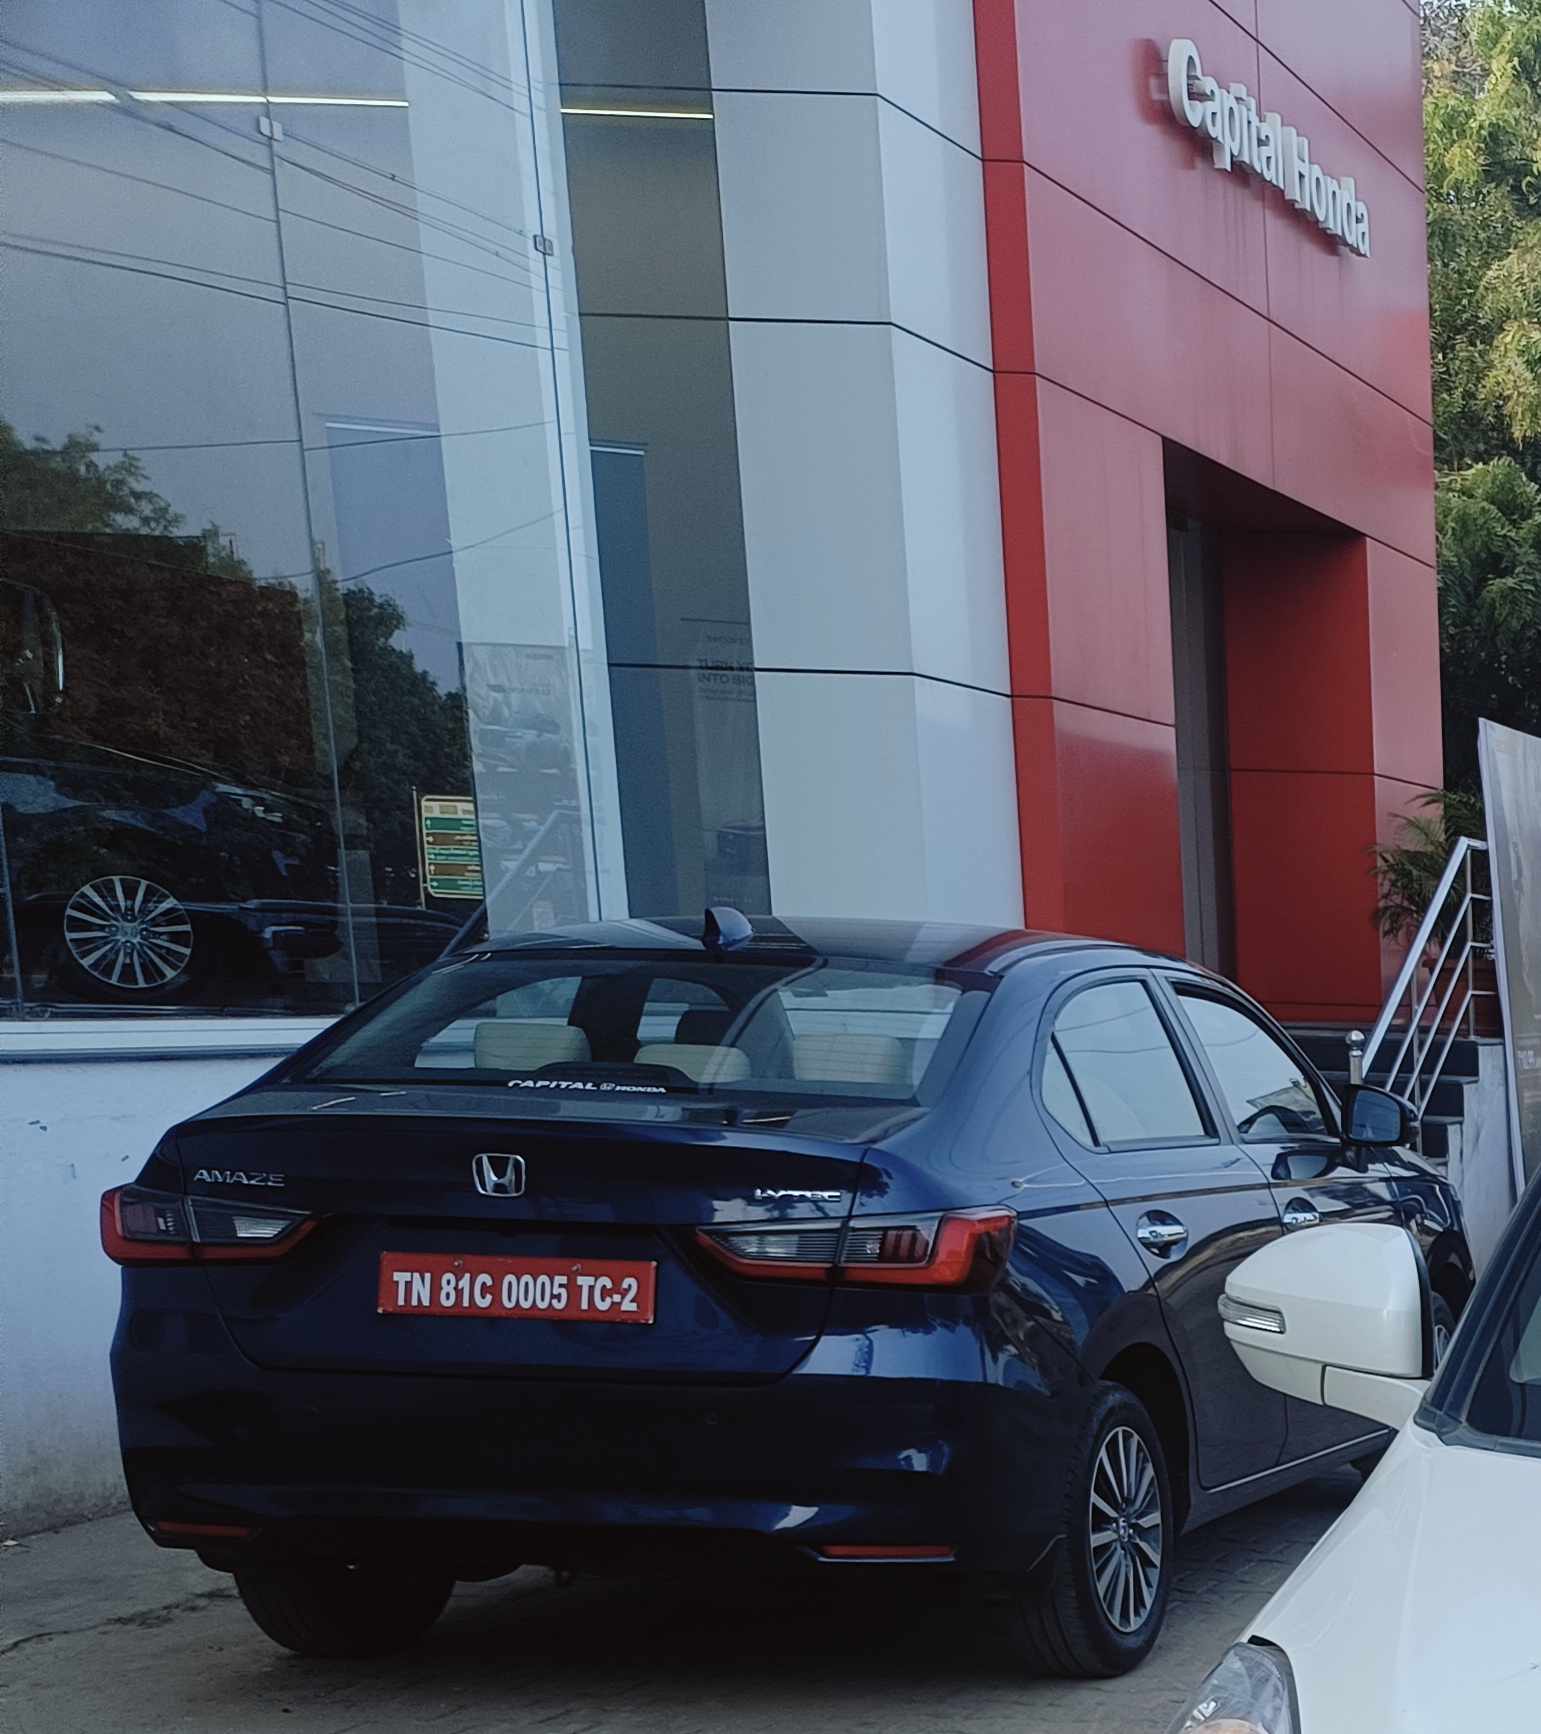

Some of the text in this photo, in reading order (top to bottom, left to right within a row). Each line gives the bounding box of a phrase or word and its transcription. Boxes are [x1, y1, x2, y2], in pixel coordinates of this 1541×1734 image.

[1168, 39, 1371, 258] Capital Honda
[508, 1079, 667, 1094] CAPITAL HONDA
[193, 1169, 285, 1187] AMAZE
[393, 1271, 638, 1312] TN 81C 0005 TC-2
